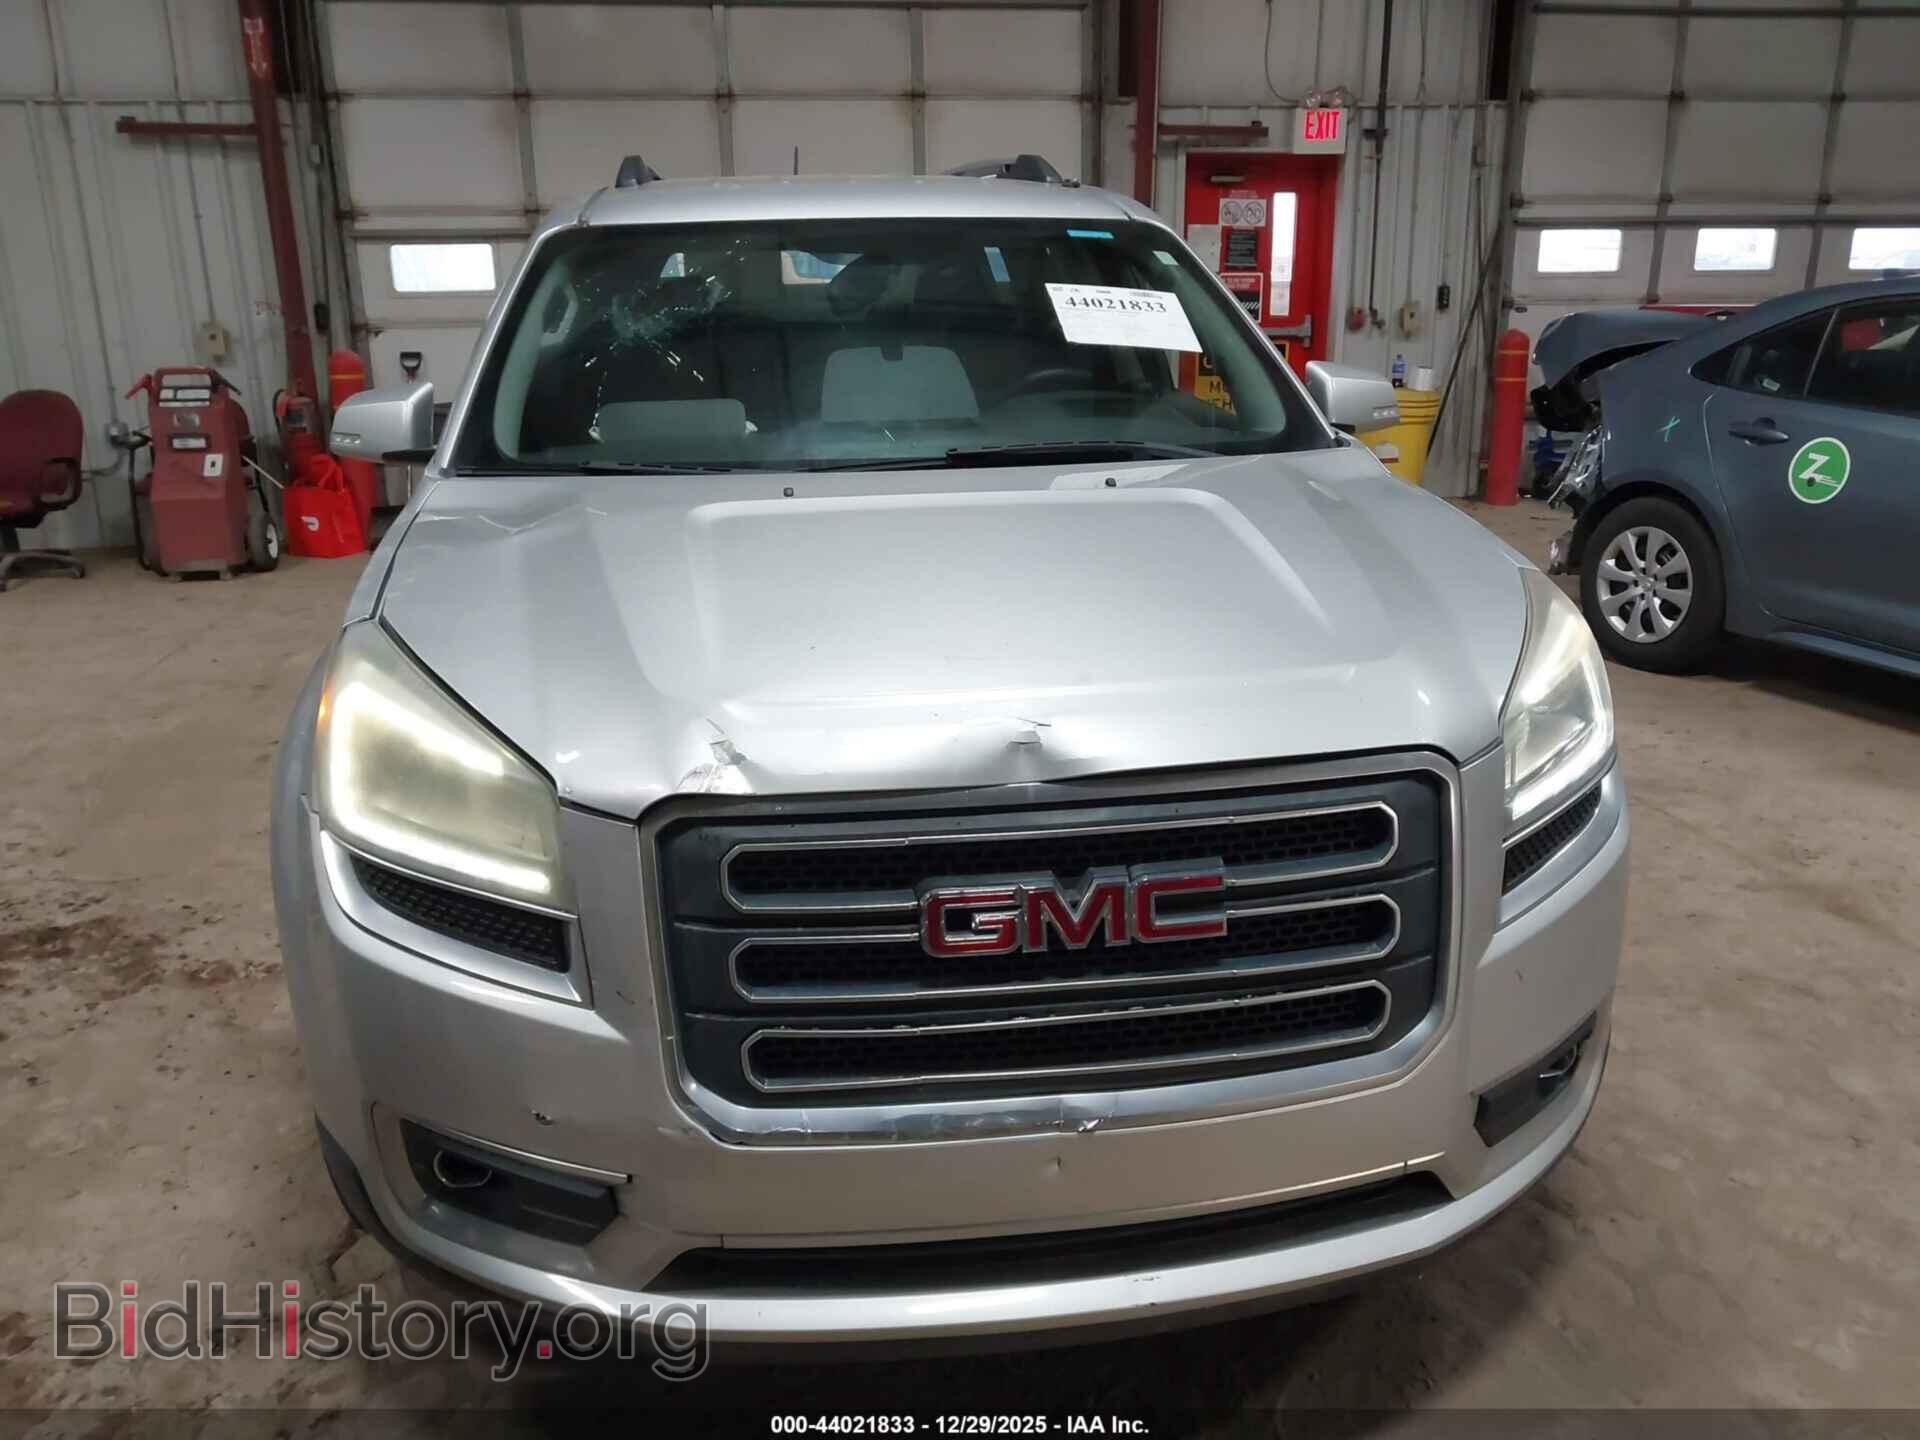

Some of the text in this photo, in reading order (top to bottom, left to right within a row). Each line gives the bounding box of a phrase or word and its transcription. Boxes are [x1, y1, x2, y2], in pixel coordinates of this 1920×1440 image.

[1304, 111, 1340, 140] EXIT
[1065, 296, 1168, 314] 44021833
[917, 858, 1227, 958] GMC
